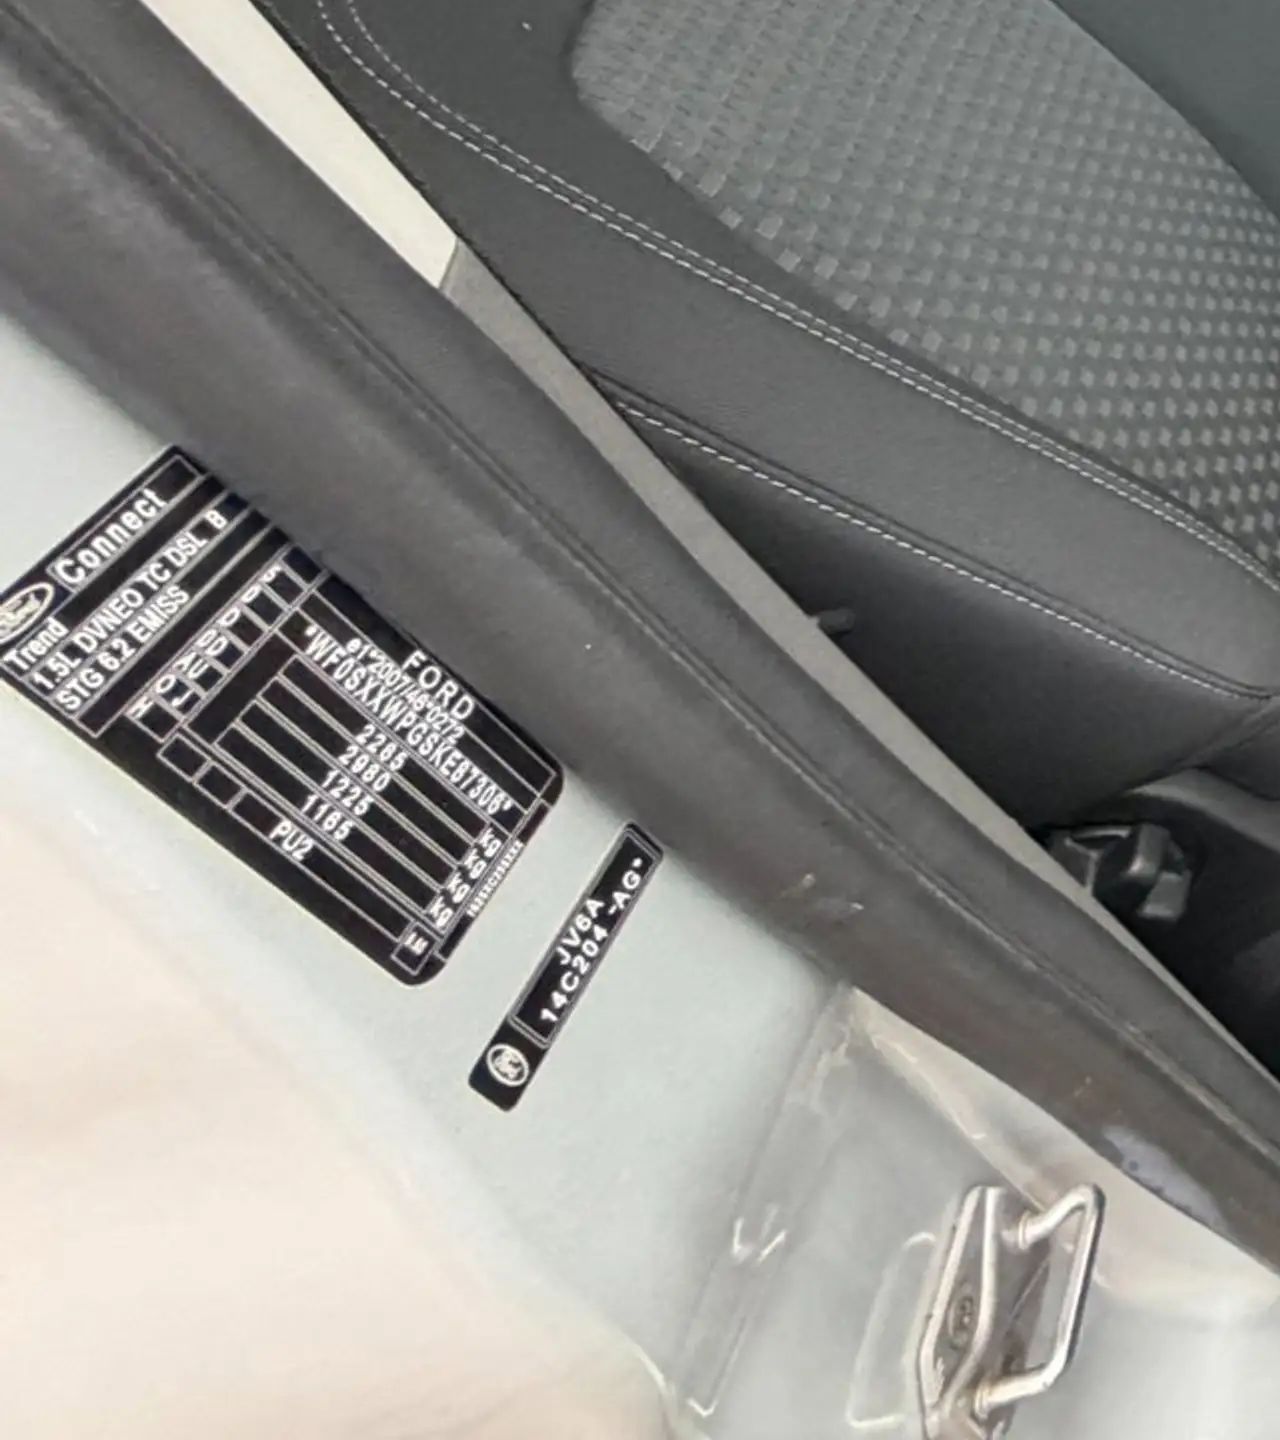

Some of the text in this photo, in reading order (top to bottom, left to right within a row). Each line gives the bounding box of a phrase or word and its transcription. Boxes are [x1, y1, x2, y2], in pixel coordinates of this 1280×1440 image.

[56, 488, 167, 584] Connect
[4, 615, 68, 671] Trend
[33, 650, 81, 690] 1.5L
[77, 581, 147, 654] DVNEO
[137, 560, 173, 591] TC
[166, 531, 207, 566] DSL
[56, 585, 190, 710] STG 6.2 EMISS
[400, 650, 474, 720] FORD
[268, 820, 315, 861] PU2
[301, 793, 453, 928] 1165 kg
[321, 768, 376, 817] 1225
[448, 872, 470, 904] kg
[339, 745, 392, 792] 2980
[464, 848, 487, 880] kg
[480, 827, 502, 858] kg
[540, 925, 608, 1023] 14C204
[556, 897, 605, 965] JV6A
